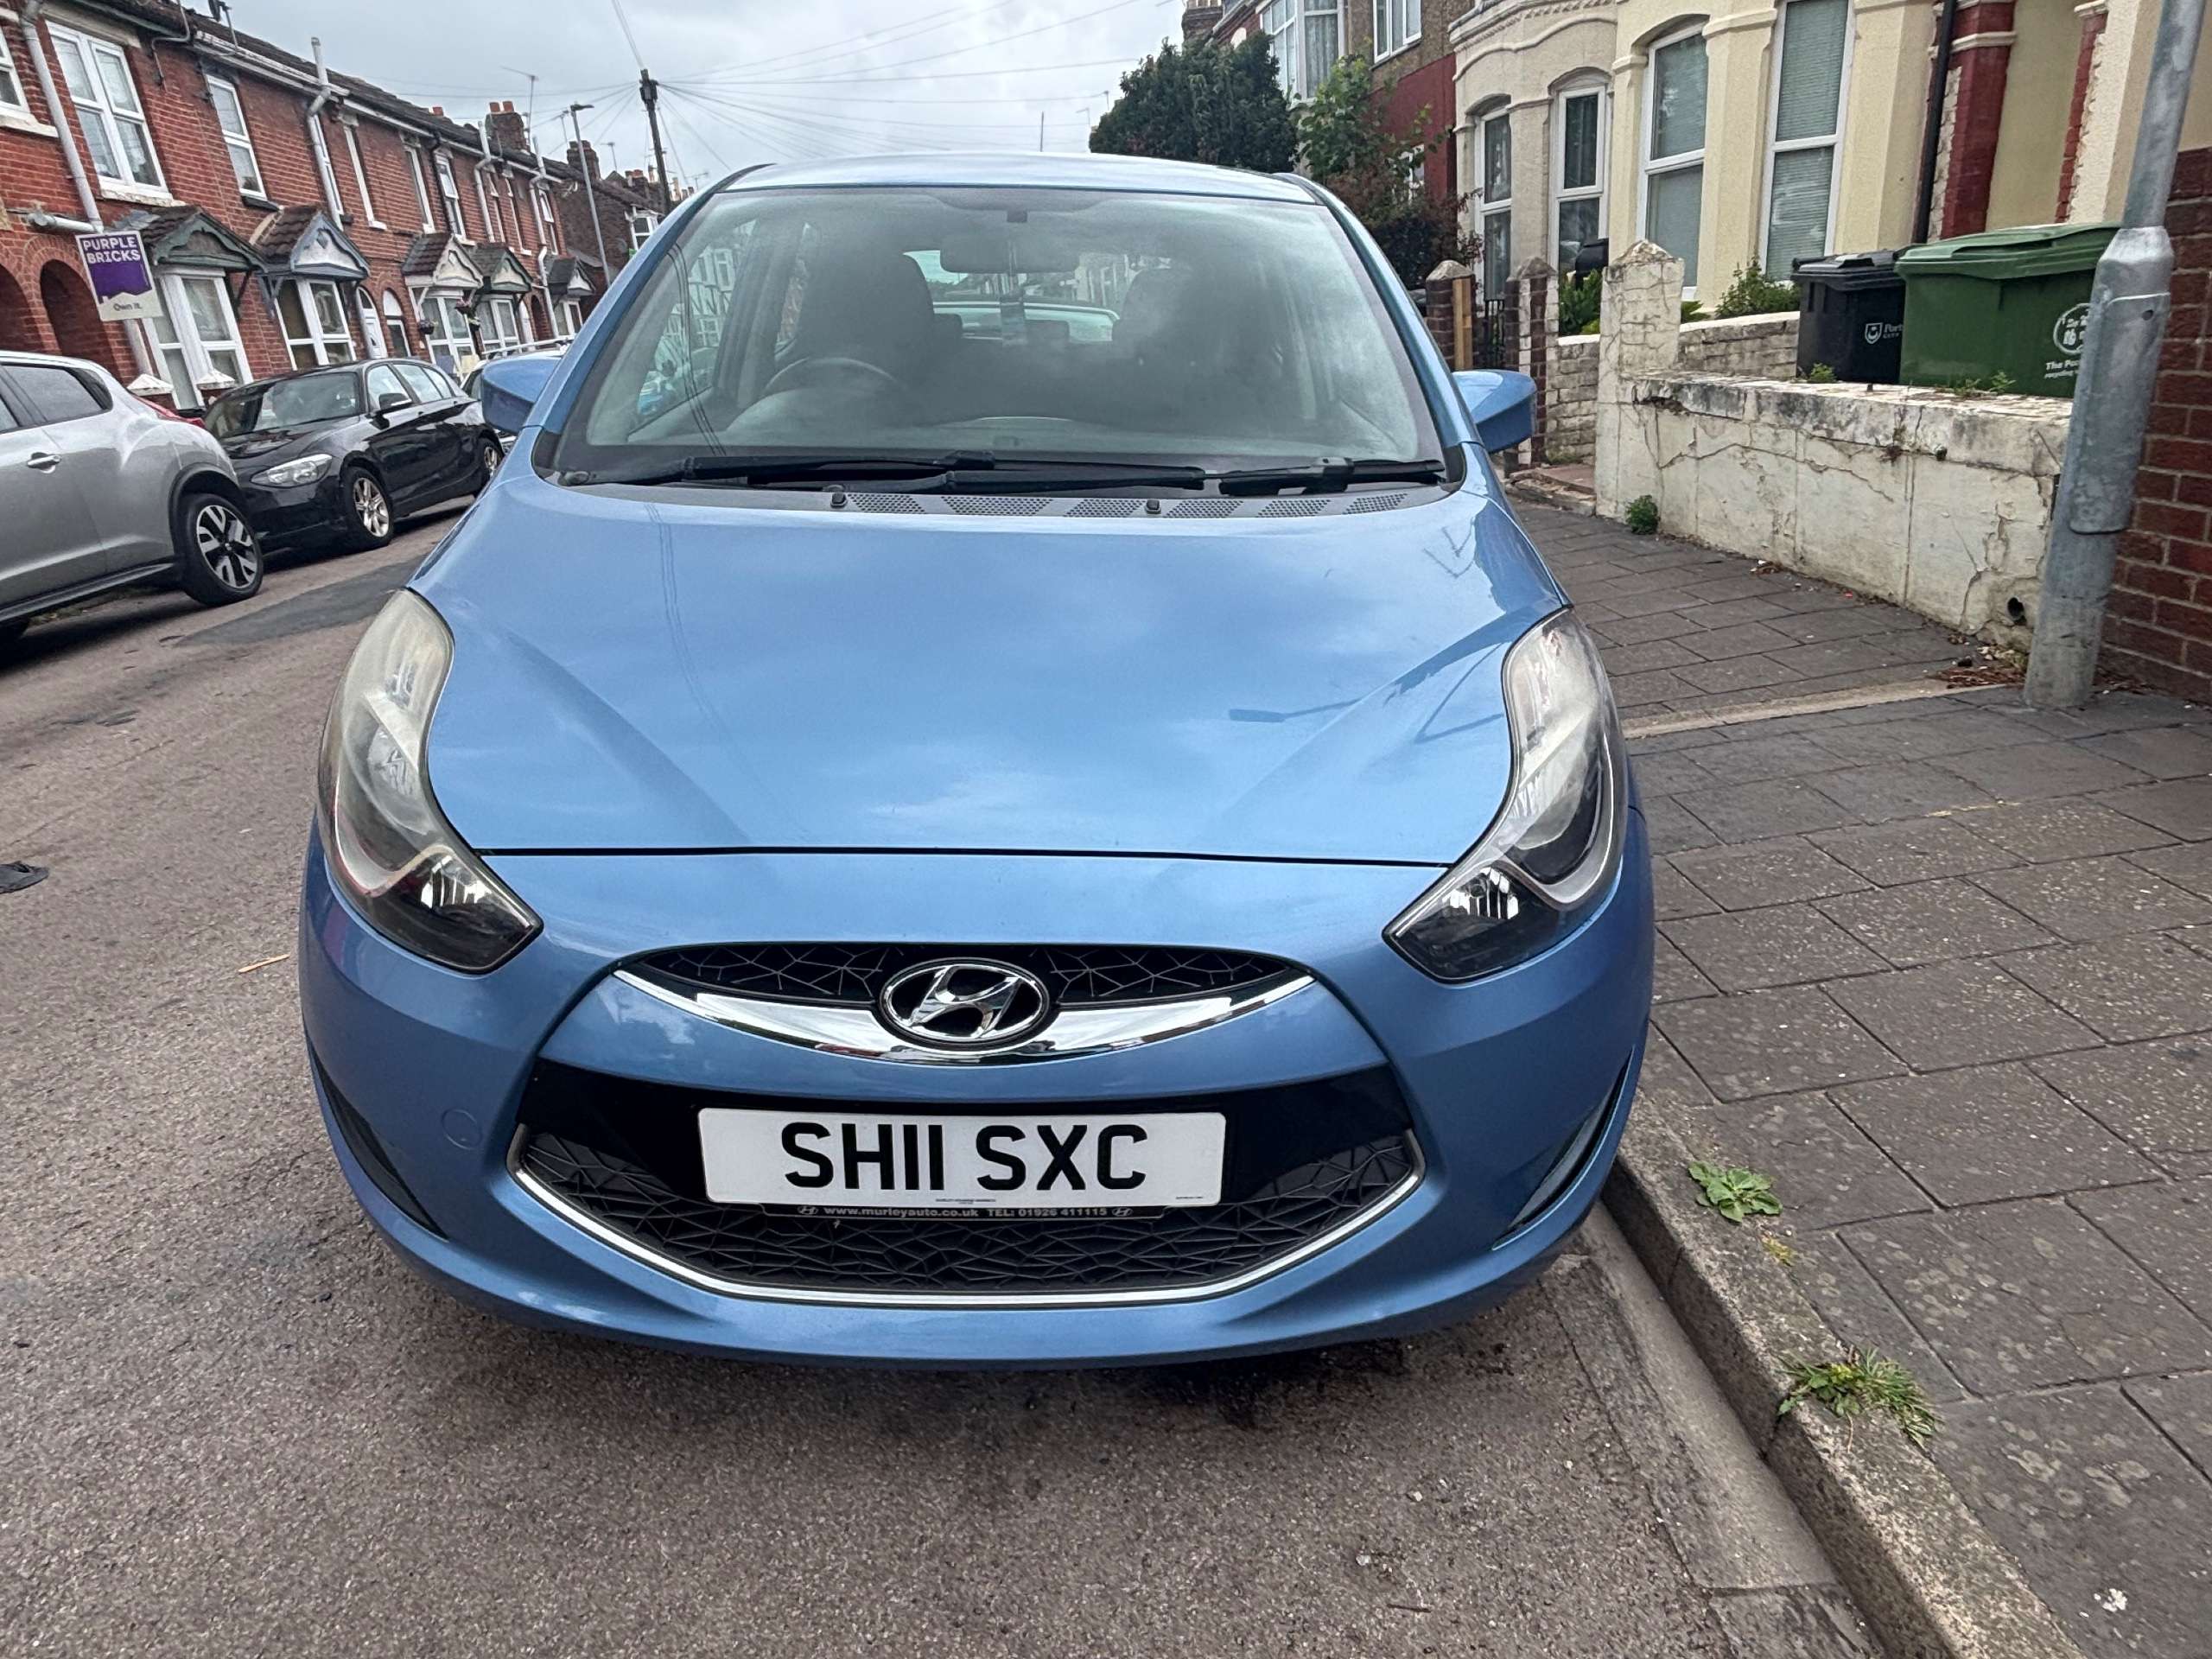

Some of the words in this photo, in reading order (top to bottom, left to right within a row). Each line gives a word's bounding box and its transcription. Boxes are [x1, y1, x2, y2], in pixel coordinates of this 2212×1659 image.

[83, 237, 137, 251] PURPLE
[86, 250, 141, 264] BRICKS
[976, 1124, 1147, 1191] SXC
[823, 1207, 979, 1218] www.murleyauto.co.uk
[1018, 1208, 1058, 1217] 01926
